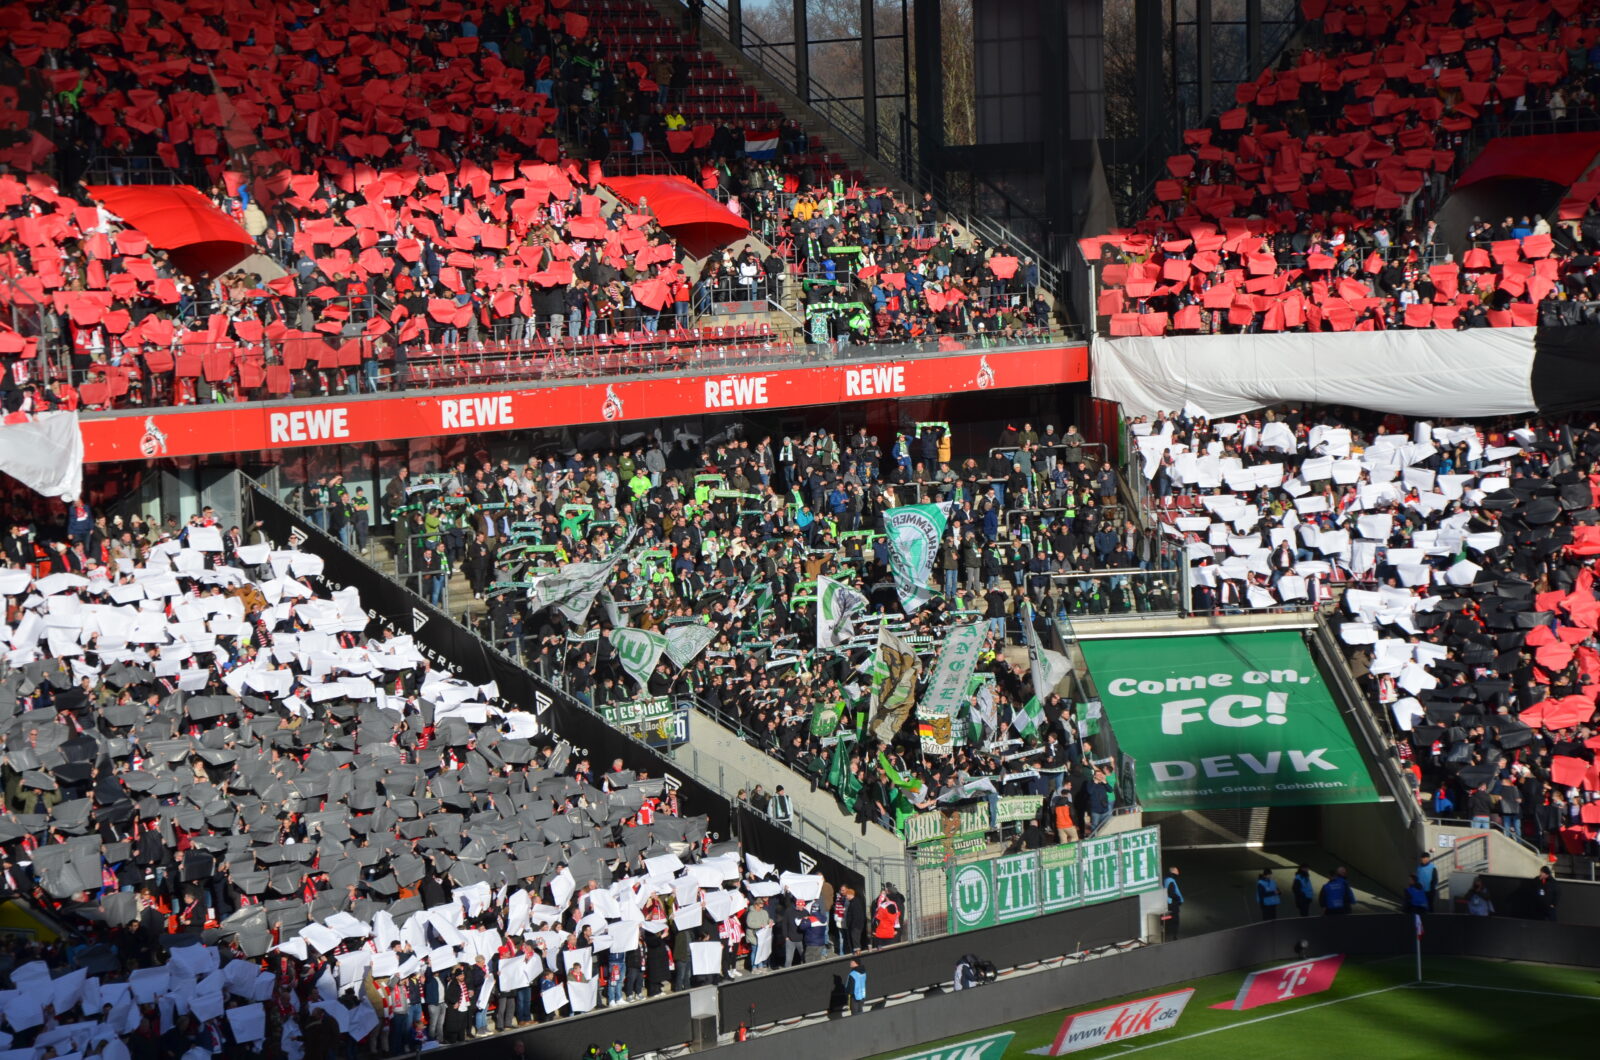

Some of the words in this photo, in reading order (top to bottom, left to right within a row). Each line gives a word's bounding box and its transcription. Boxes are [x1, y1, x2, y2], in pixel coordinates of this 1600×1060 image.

[705, 376, 768, 408] REWE
[846, 366, 905, 397] REWE
[270, 408, 349, 443] REWE
[441, 395, 514, 428] REWE
[1107, 672, 1233, 697] Come
[1242, 669, 1311, 685] on,
[1161, 691, 1289, 736] FC!
[1150, 748, 1340, 782] DEVK
[1222, 784, 1271, 794] Getan.
[1275, 780, 1348, 792] Geholfen.
